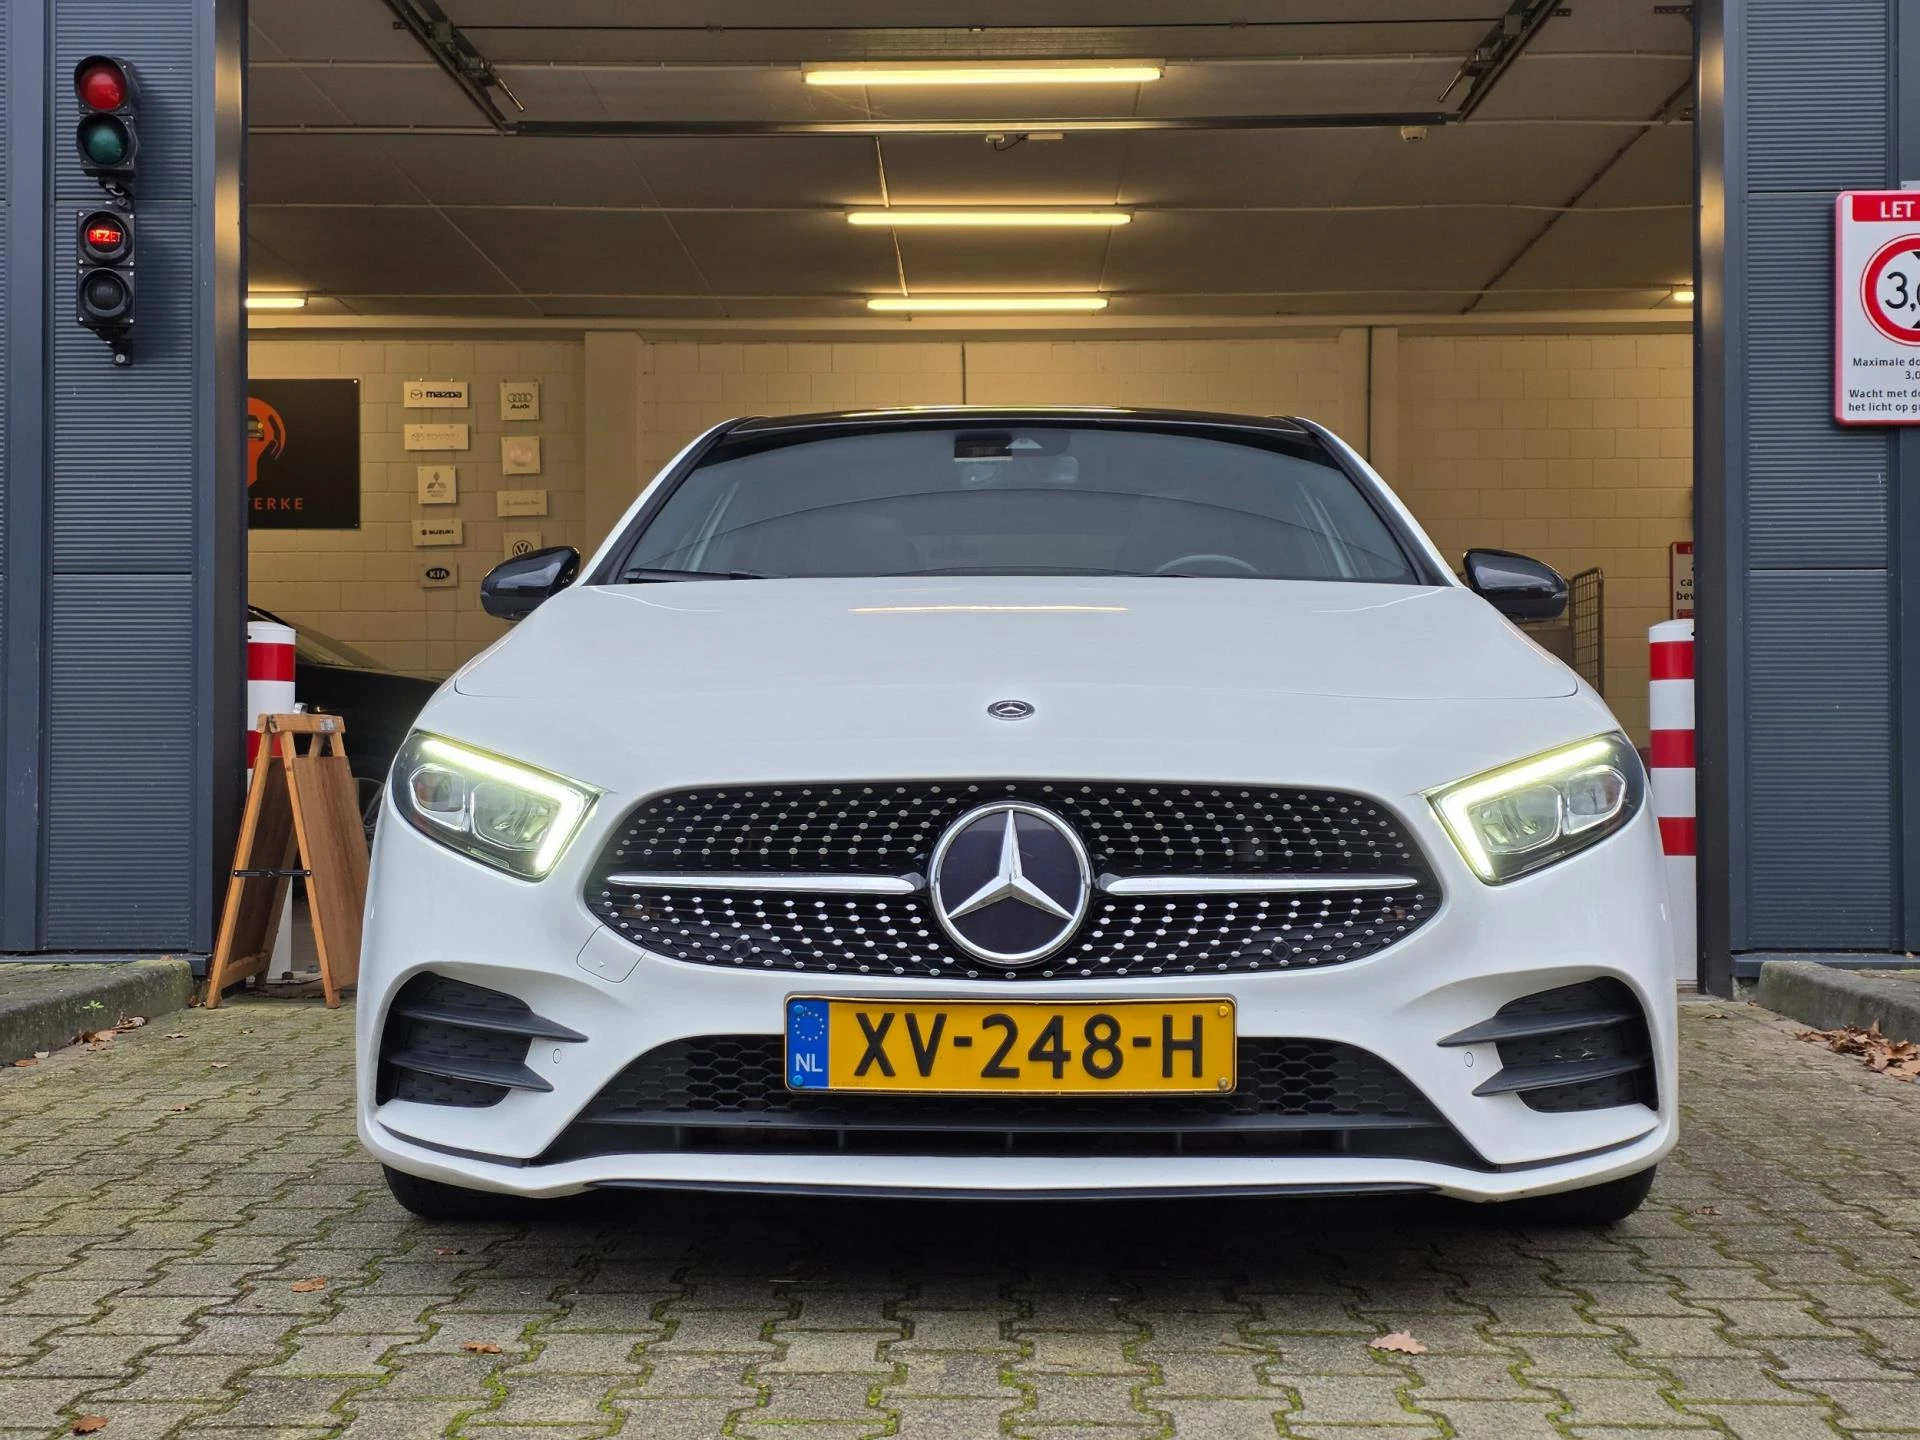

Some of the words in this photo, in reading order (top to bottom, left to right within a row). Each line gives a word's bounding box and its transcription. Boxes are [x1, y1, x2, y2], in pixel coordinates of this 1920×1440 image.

[1880, 200, 1916, 218] LET
[90, 230, 121, 242] BEZET
[1885, 271, 1920, 312] 3,
[1853, 357, 1906, 367] Maximale
[1849, 389, 1883, 398] Wacht
[1887, 389, 1908, 398] met
[1848, 402, 1866, 411] het
[1869, 402, 1893, 411] licht
[1895, 403, 1909, 414] op
[248, 497, 304, 510] ERKE
[429, 569, 447, 578] KIA
[795, 1053, 823, 1073] NL
[854, 1012, 1204, 1080] XV-248-H
